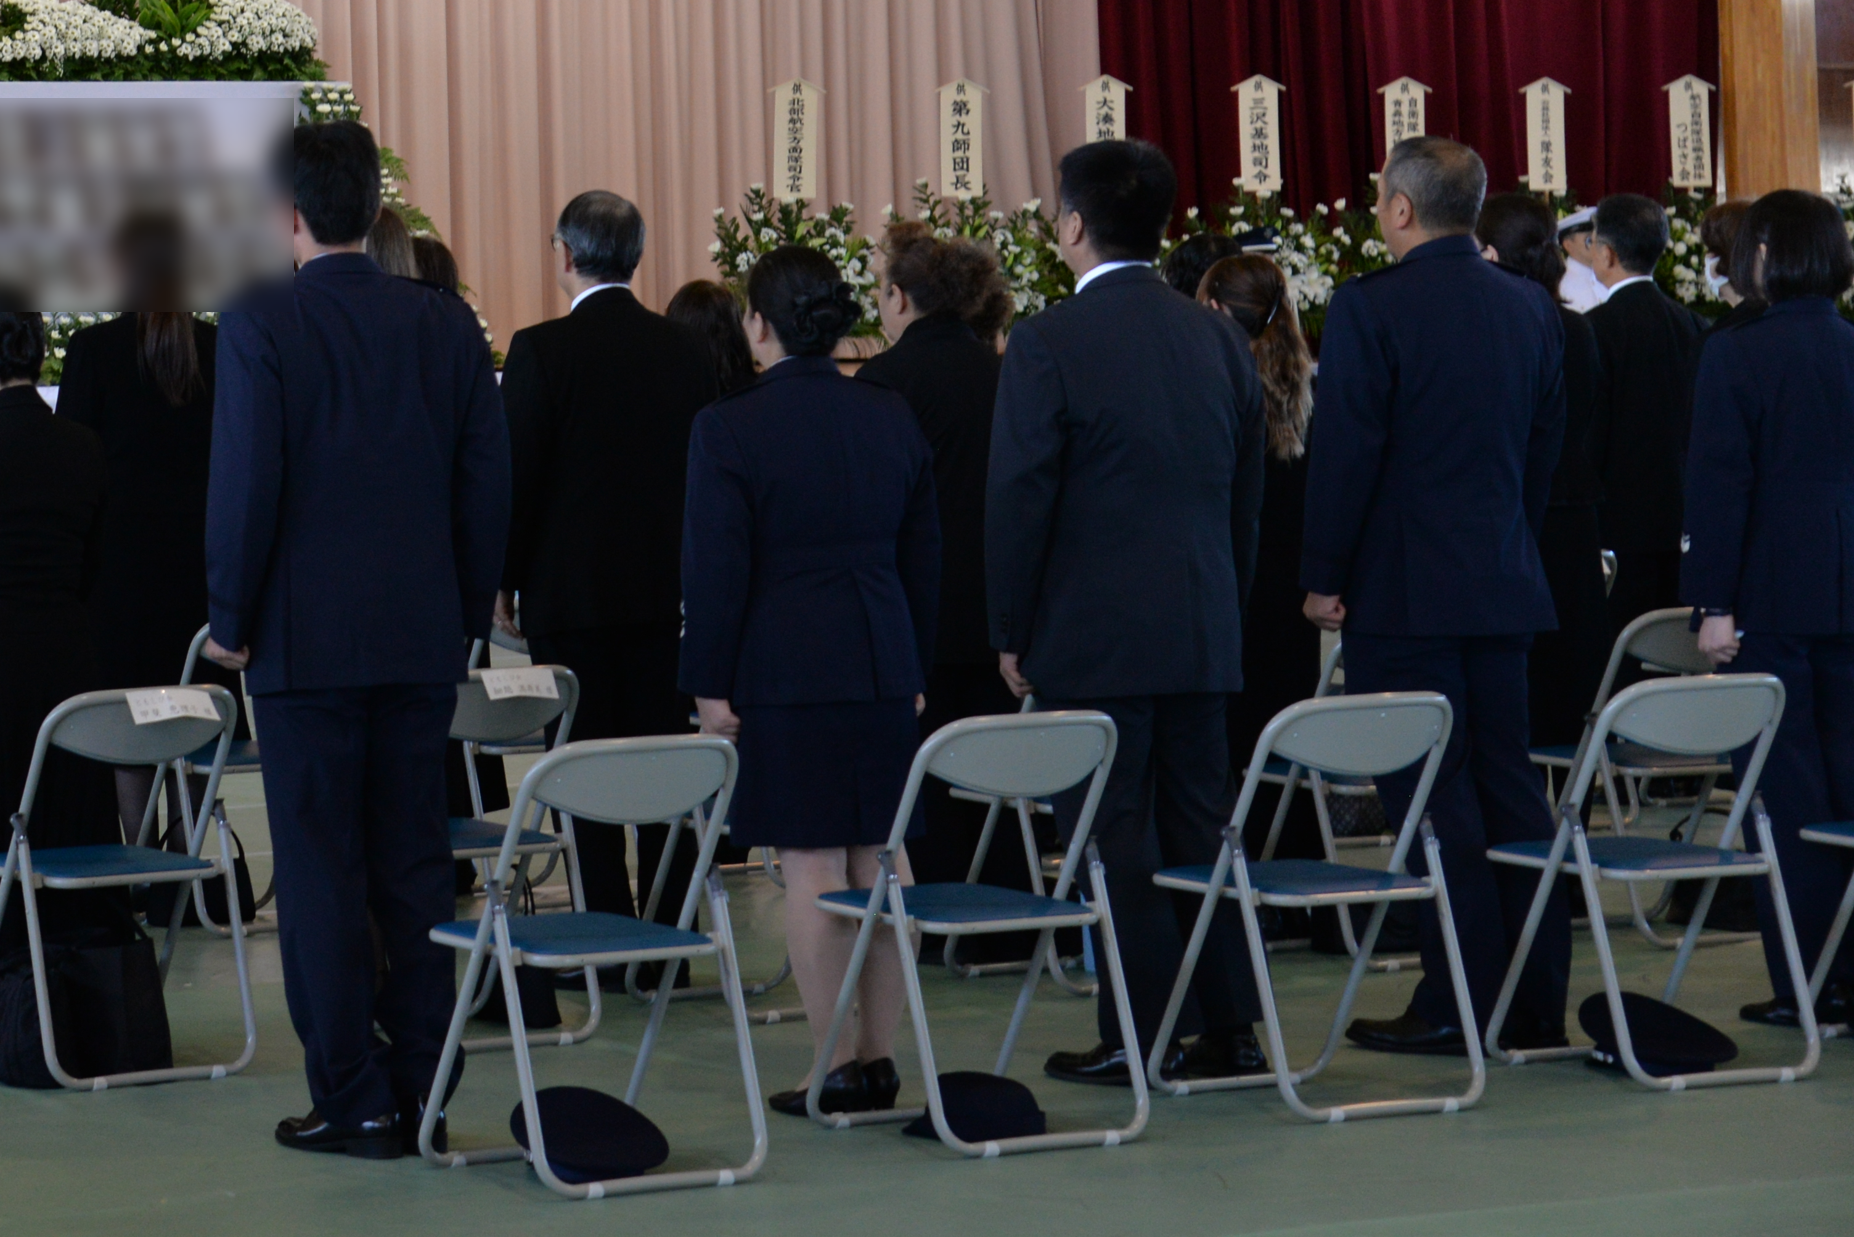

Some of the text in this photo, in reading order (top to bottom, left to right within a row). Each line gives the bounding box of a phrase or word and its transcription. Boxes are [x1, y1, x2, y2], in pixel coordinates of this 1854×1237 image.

[786, 97, 805, 193] 北部航空方面隊司令官
[950, 98, 973, 192] 第九師団長
[1248, 96, 1270, 186] 三沢基地司令
[1676, 122, 1691, 182] つばさ会
